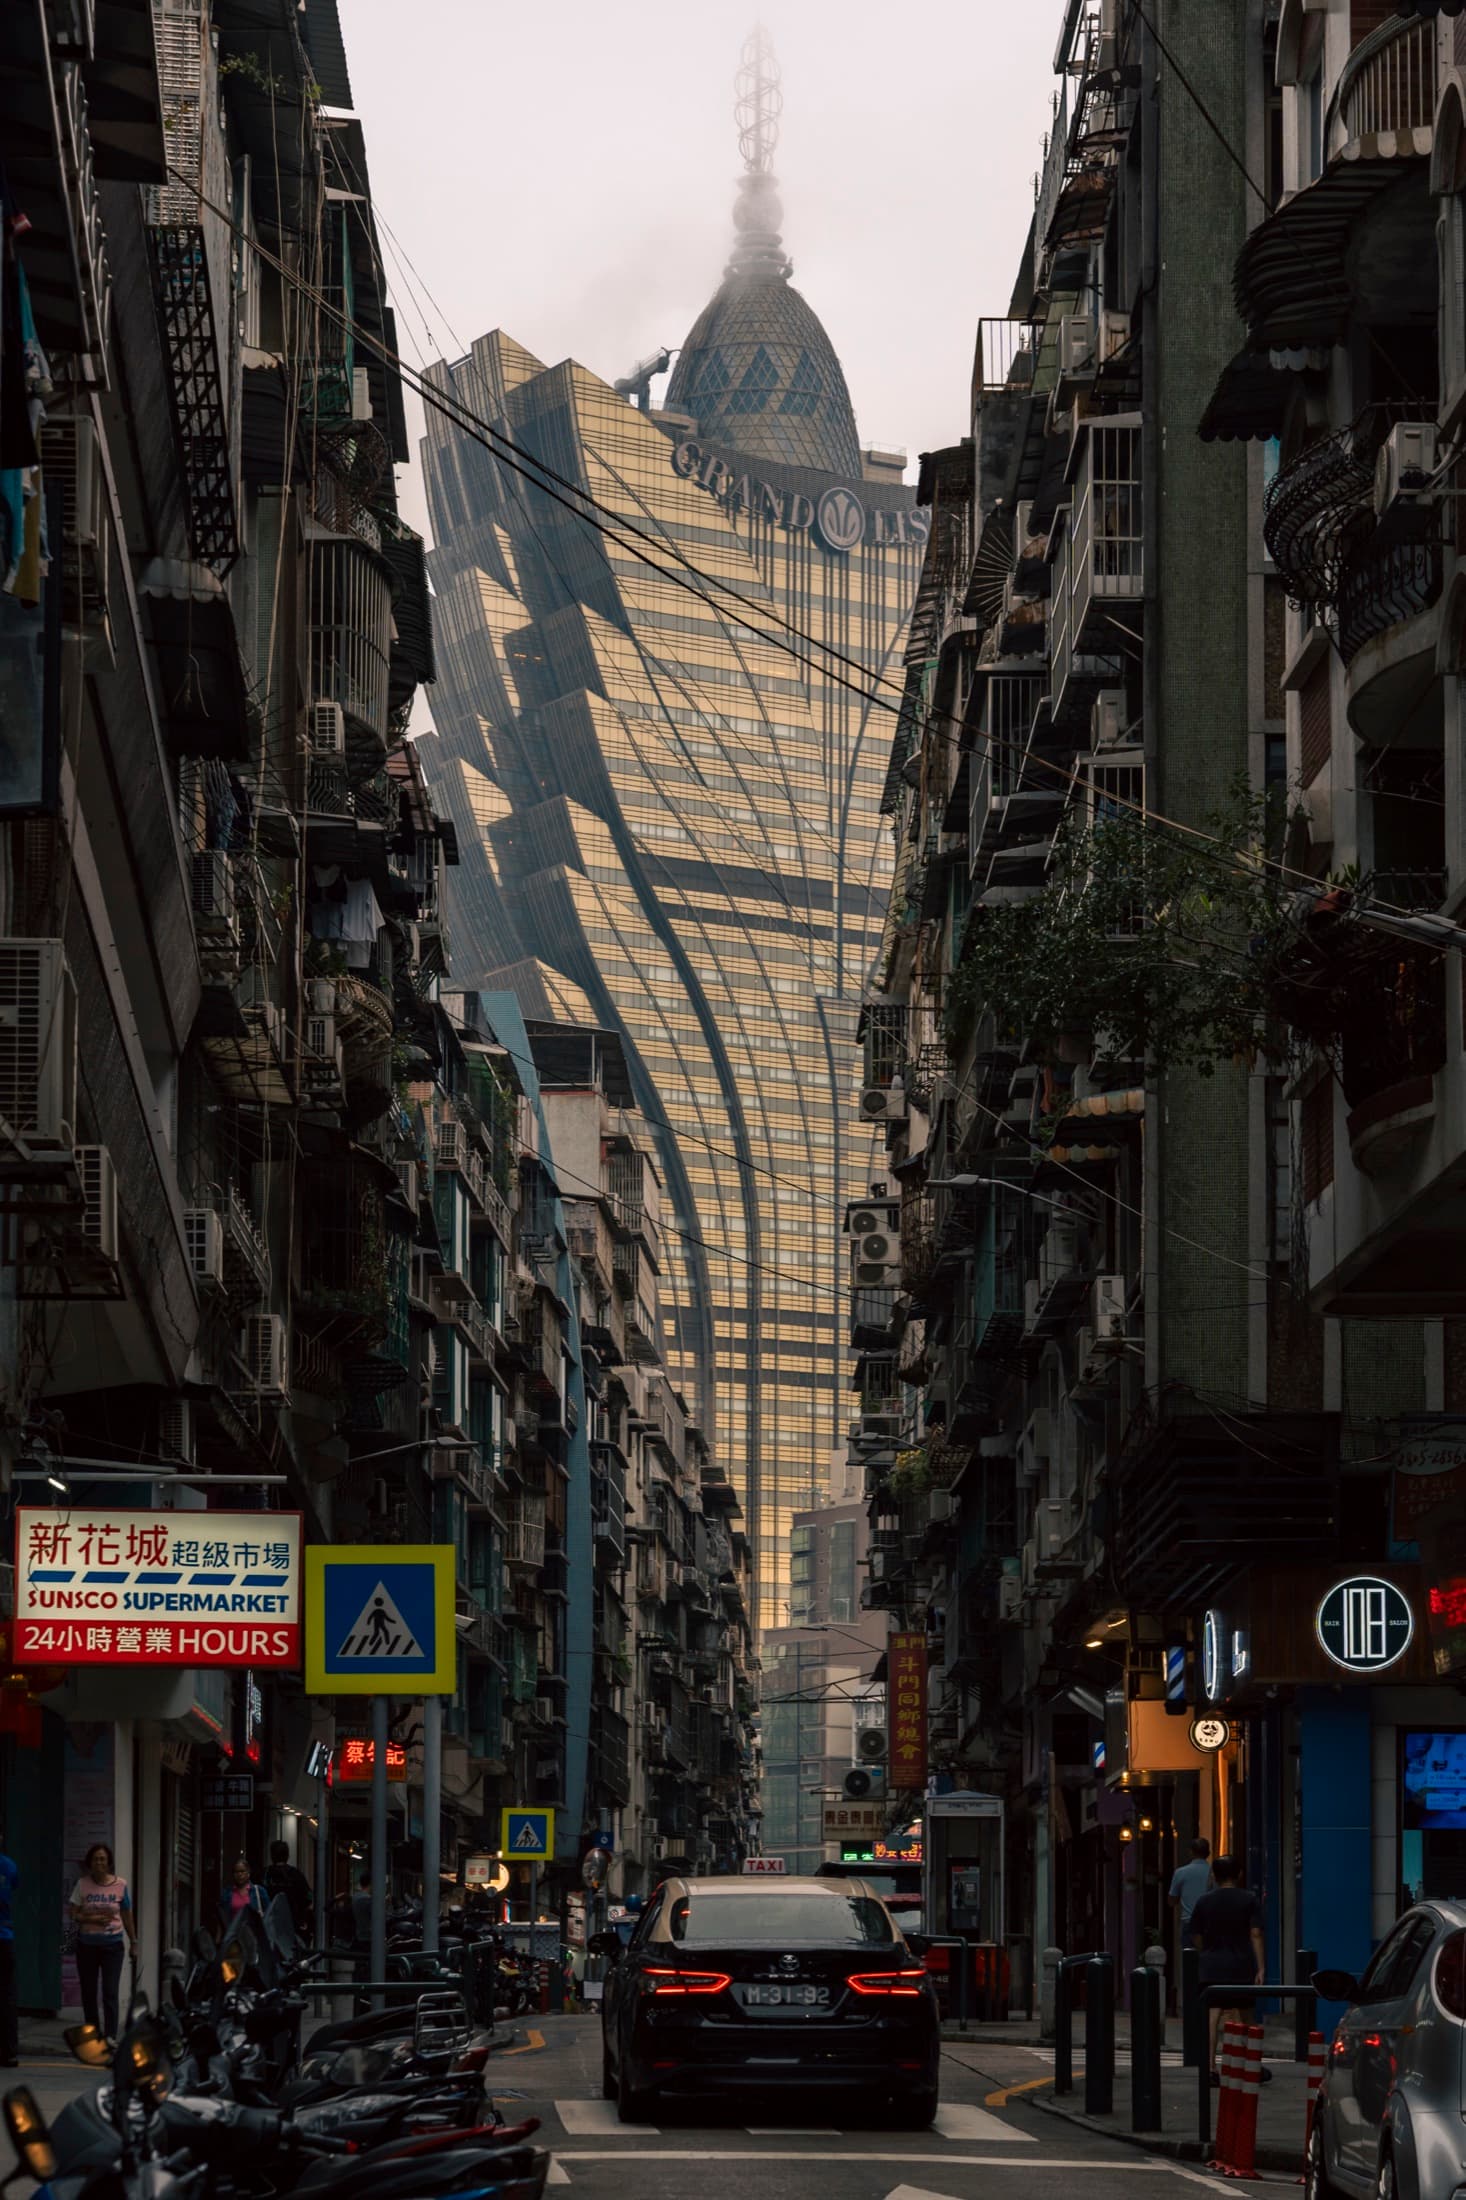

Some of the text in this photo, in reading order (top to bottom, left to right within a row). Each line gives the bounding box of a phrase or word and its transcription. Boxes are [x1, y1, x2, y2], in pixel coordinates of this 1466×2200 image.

[673, 442, 932, 543] GRAND LIS
[28, 1590, 290, 1613] SUNSCO SUPERMARKET
[178, 1628, 290, 1657] HOURS
[747, 1860, 782, 1871] TAXI
[747, 1985, 831, 2005] M-31-92
